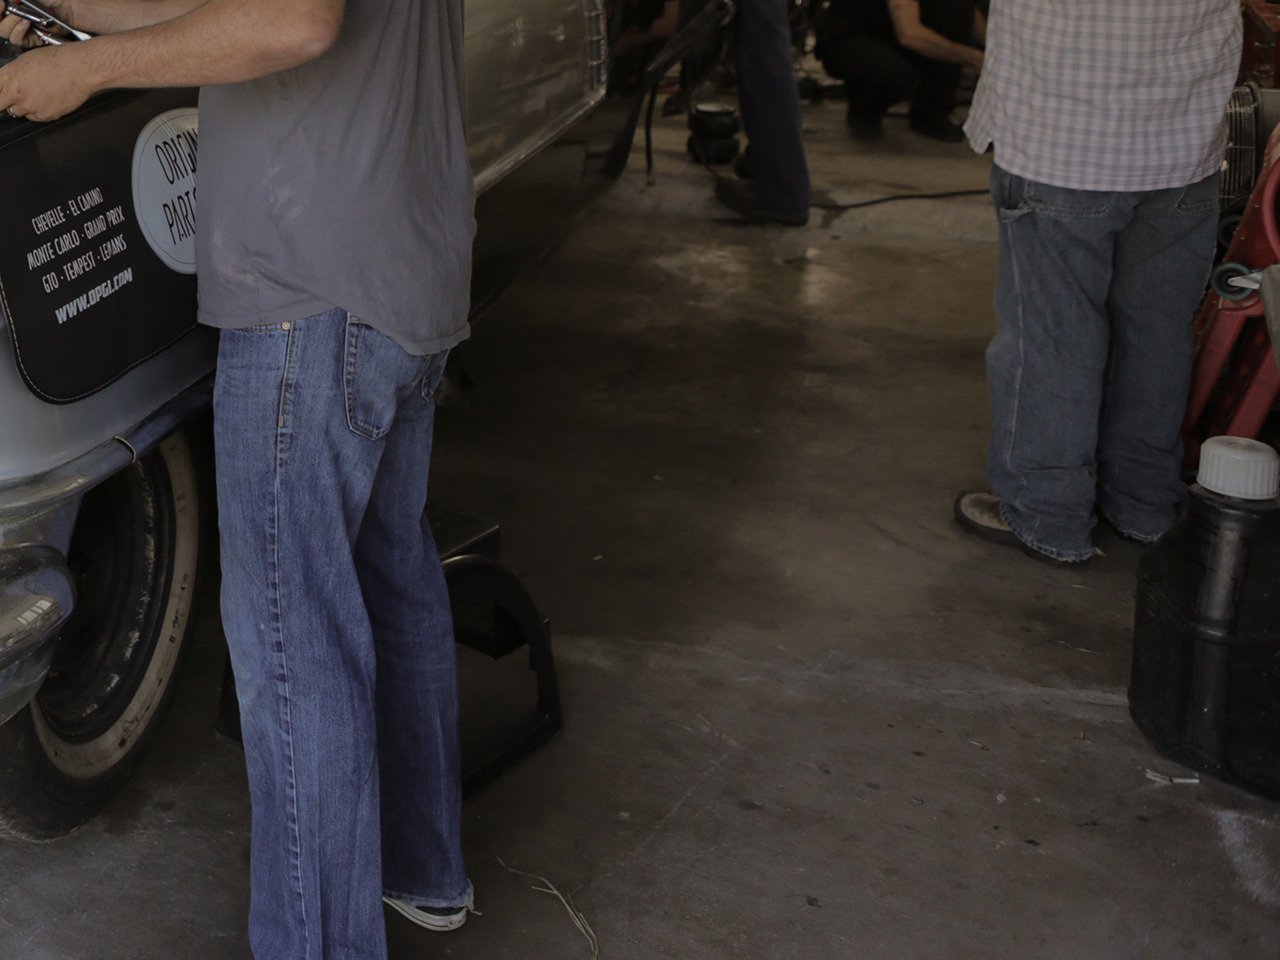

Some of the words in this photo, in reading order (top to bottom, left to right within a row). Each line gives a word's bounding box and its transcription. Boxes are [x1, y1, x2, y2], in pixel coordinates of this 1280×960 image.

[27, 242, 55, 271] MONTE
[54, 229, 80, 255] CARLO
[83, 215, 107, 240] GRAND
[106, 205, 125, 227] PRIX
[32, 206, 66, 235] CHEVELLE
[68, 199, 81, 217] EL
[78, 187, 104, 212] CAMINO
[162, 186, 197, 245] PART
[42, 272, 59, 293] GTO
[63, 251, 96, 281] TEMPEST
[55, 267, 133, 324] WWW.OPGI.COM
